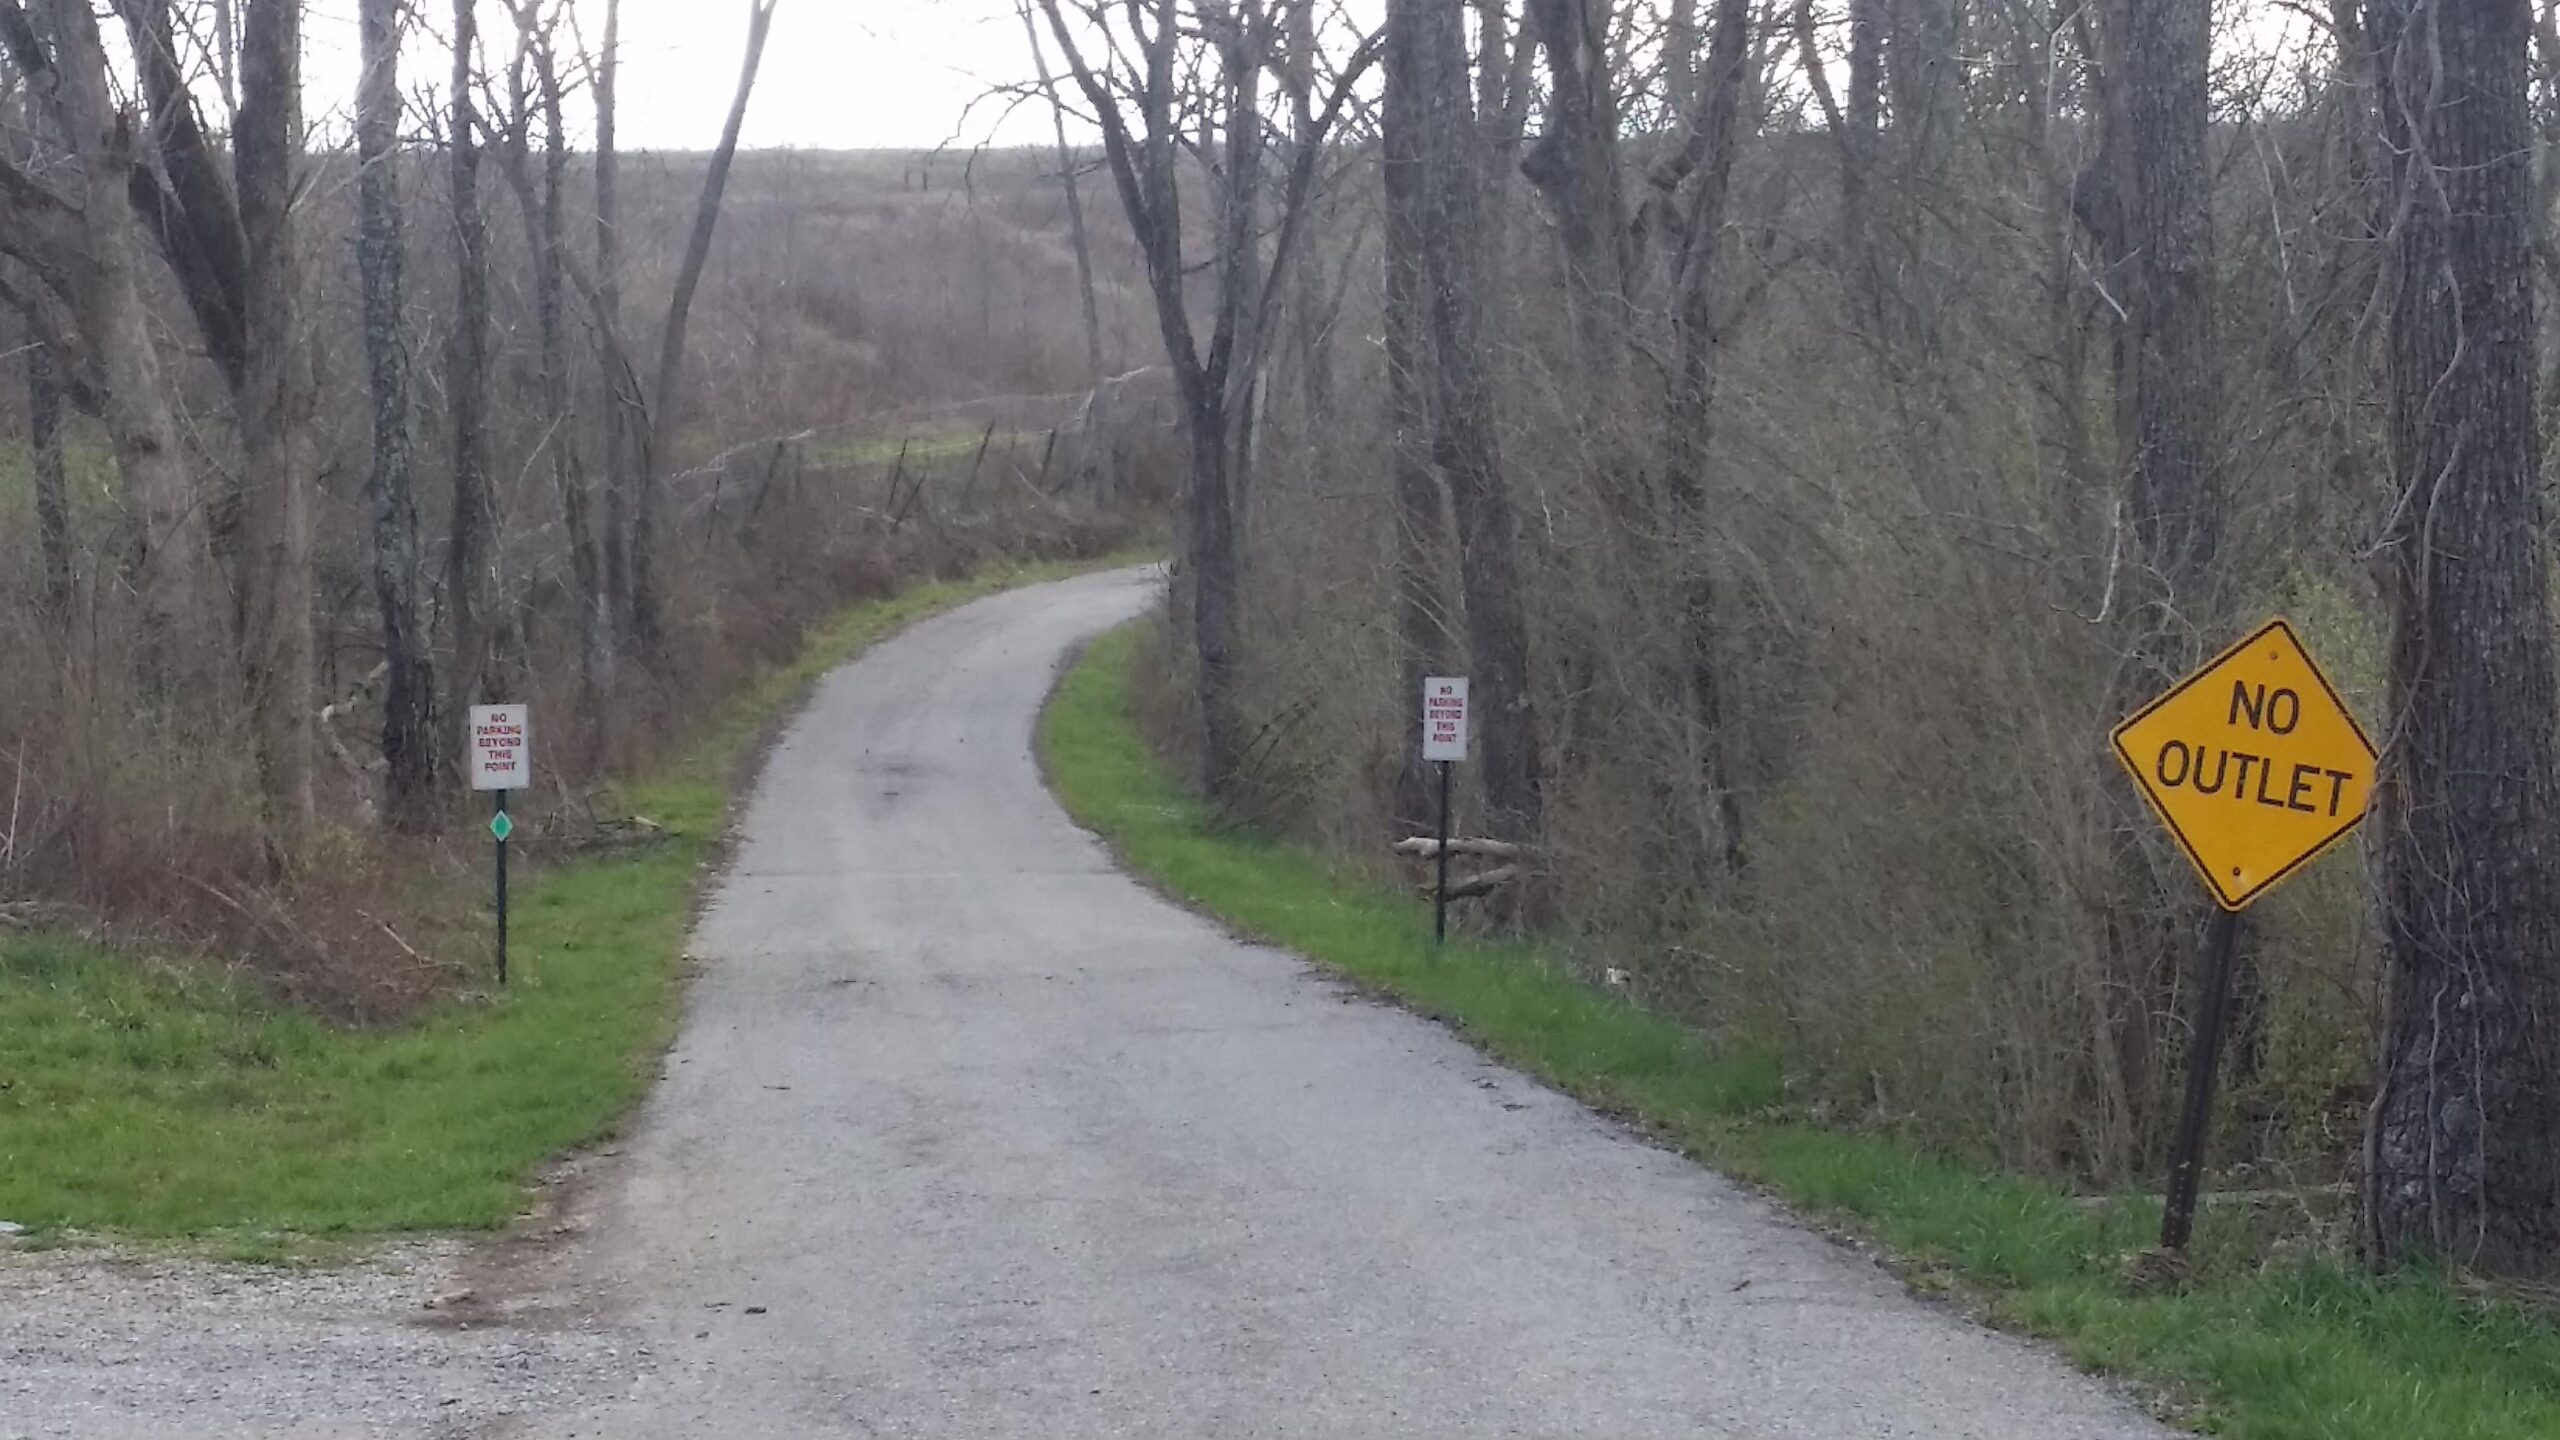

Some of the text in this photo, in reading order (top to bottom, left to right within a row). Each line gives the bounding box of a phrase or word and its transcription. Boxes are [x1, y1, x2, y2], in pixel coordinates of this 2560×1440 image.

[1440, 686, 1452, 695] NO
[2228, 680, 2300, 735] NO
[491, 713, 507, 722] NO
[477, 725, 522, 735] PARKING
[479, 737, 521, 747] BEYOND
[488, 750, 512, 760] THIS
[485, 761, 516, 771] POINT
[2157, 740, 2353, 816] OUTLET
